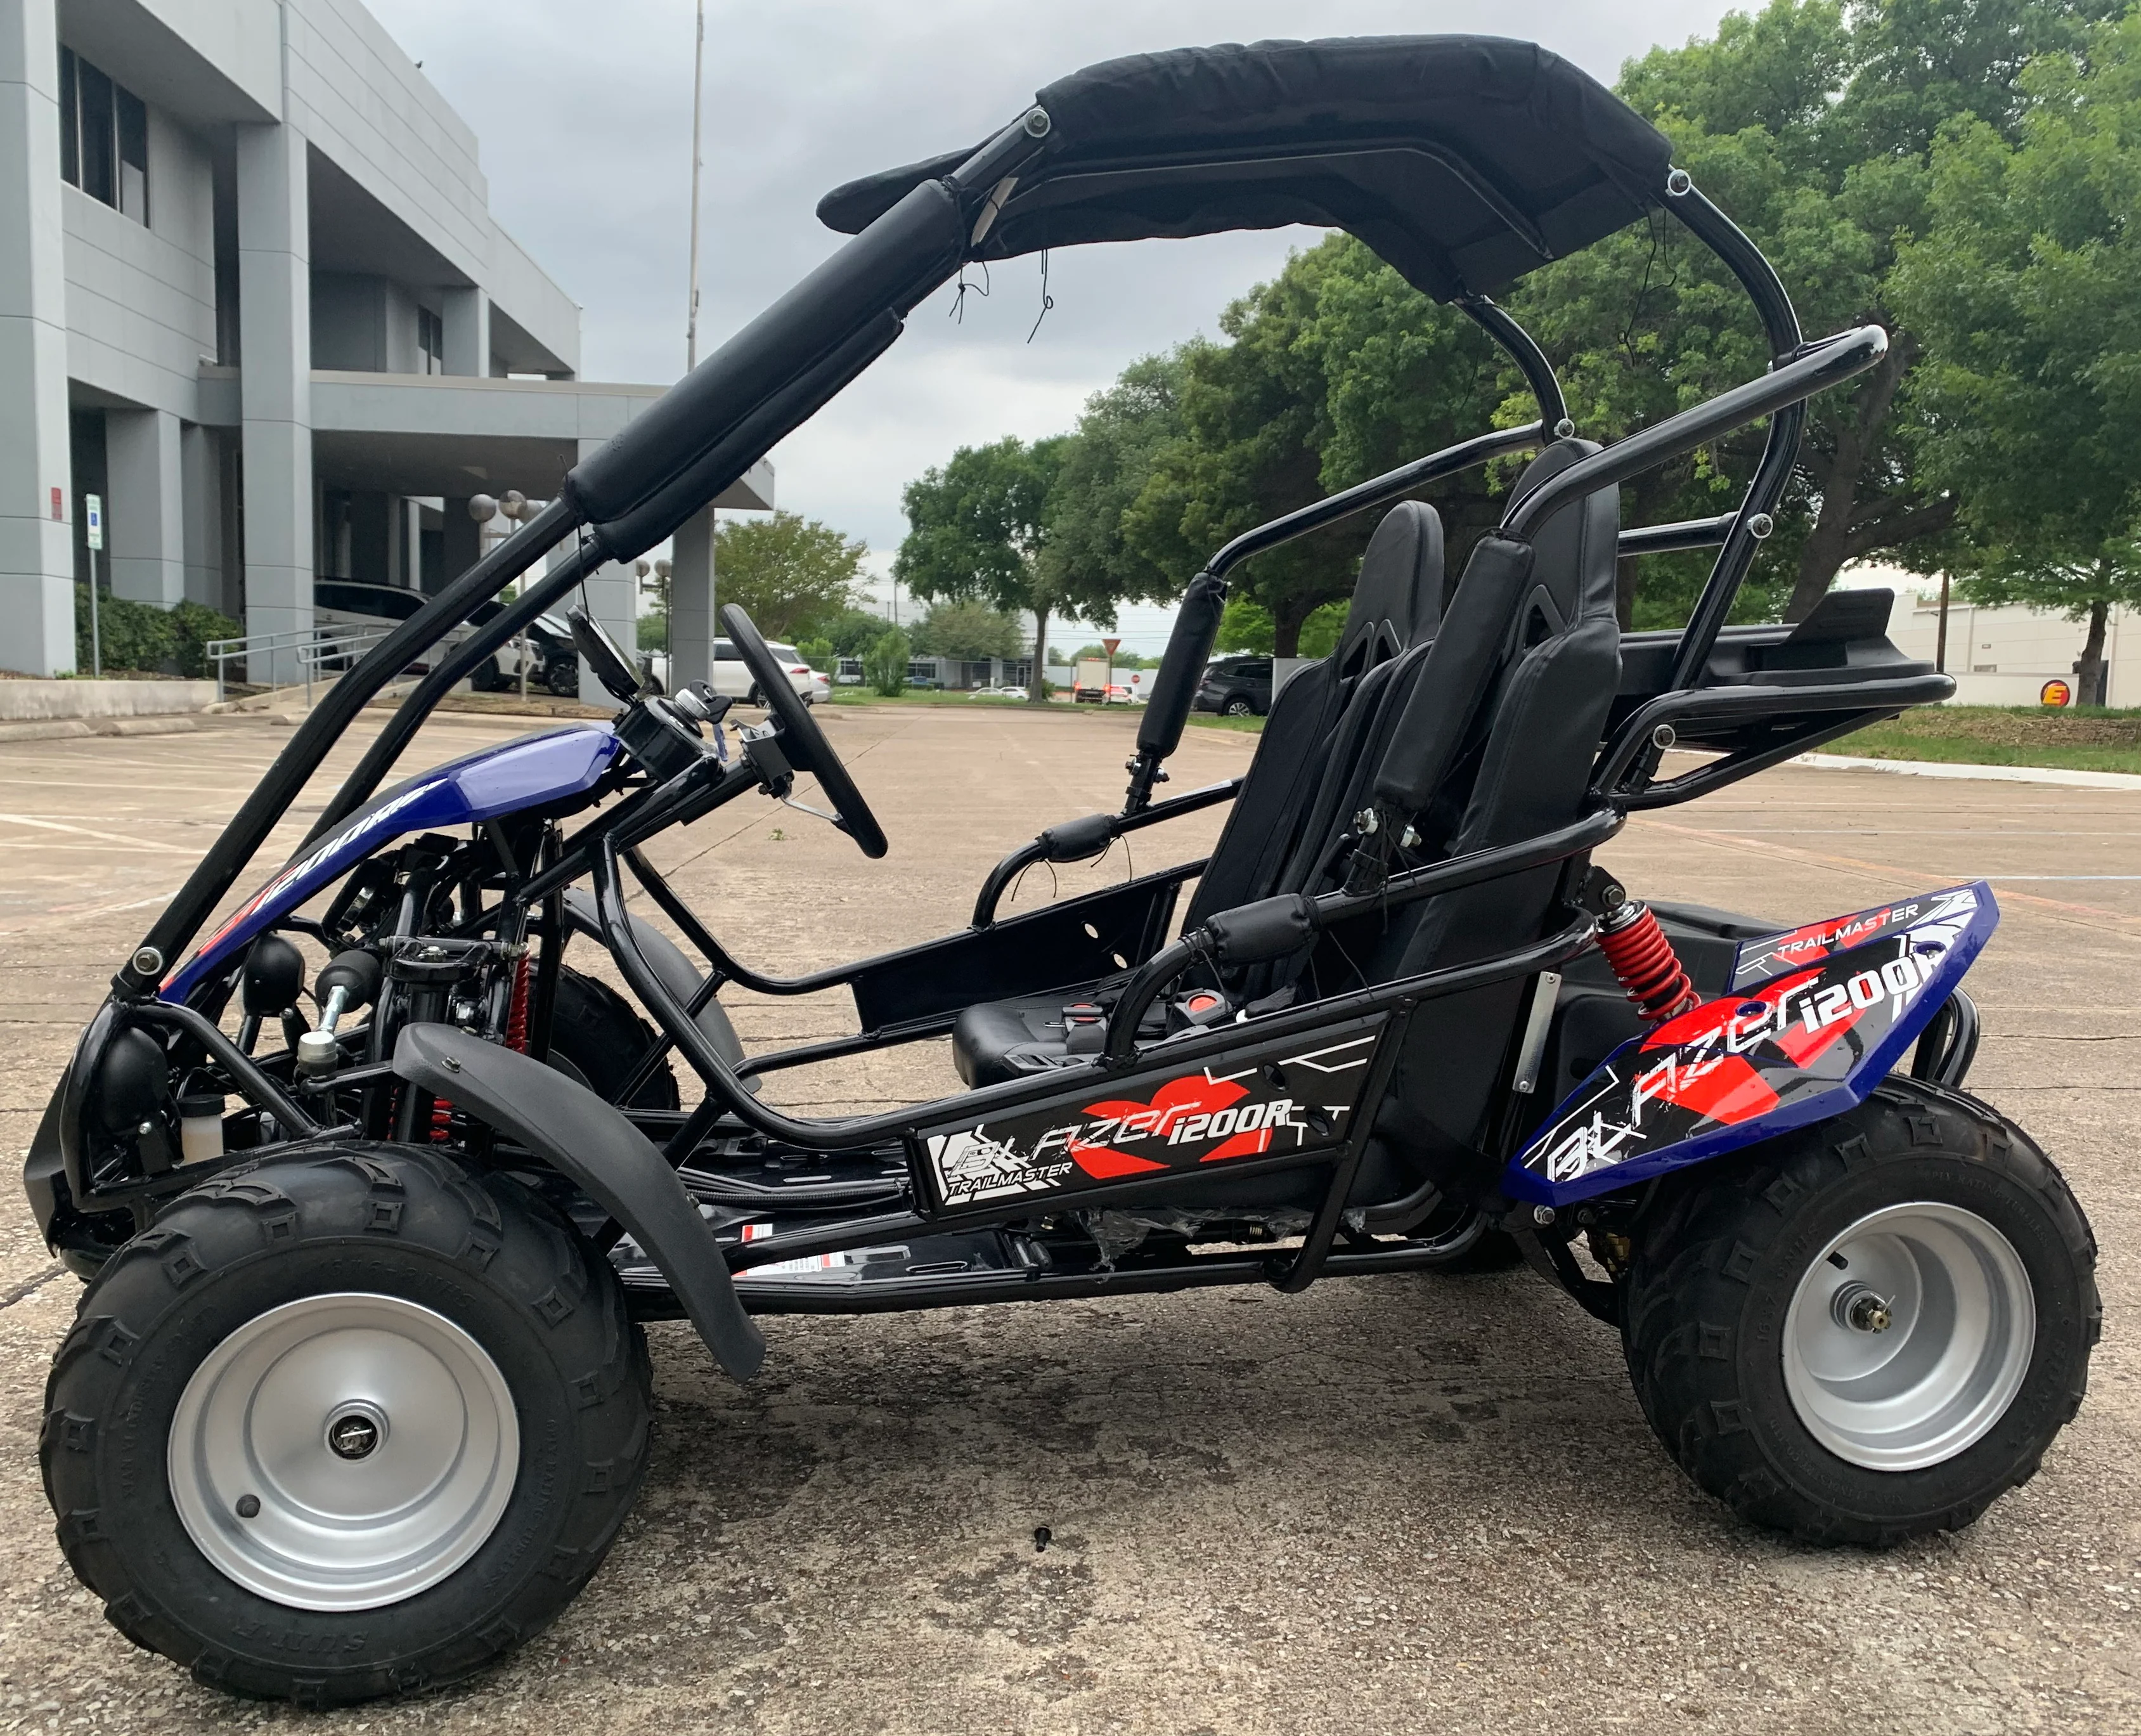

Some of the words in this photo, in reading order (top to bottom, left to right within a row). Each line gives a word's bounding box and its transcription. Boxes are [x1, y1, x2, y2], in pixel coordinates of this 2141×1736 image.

[2043, 685, 2067, 704] E
[1778, 904, 1919, 957] TRAILMASTER
[948, 1162, 1073, 1196] TRAILMASTER
